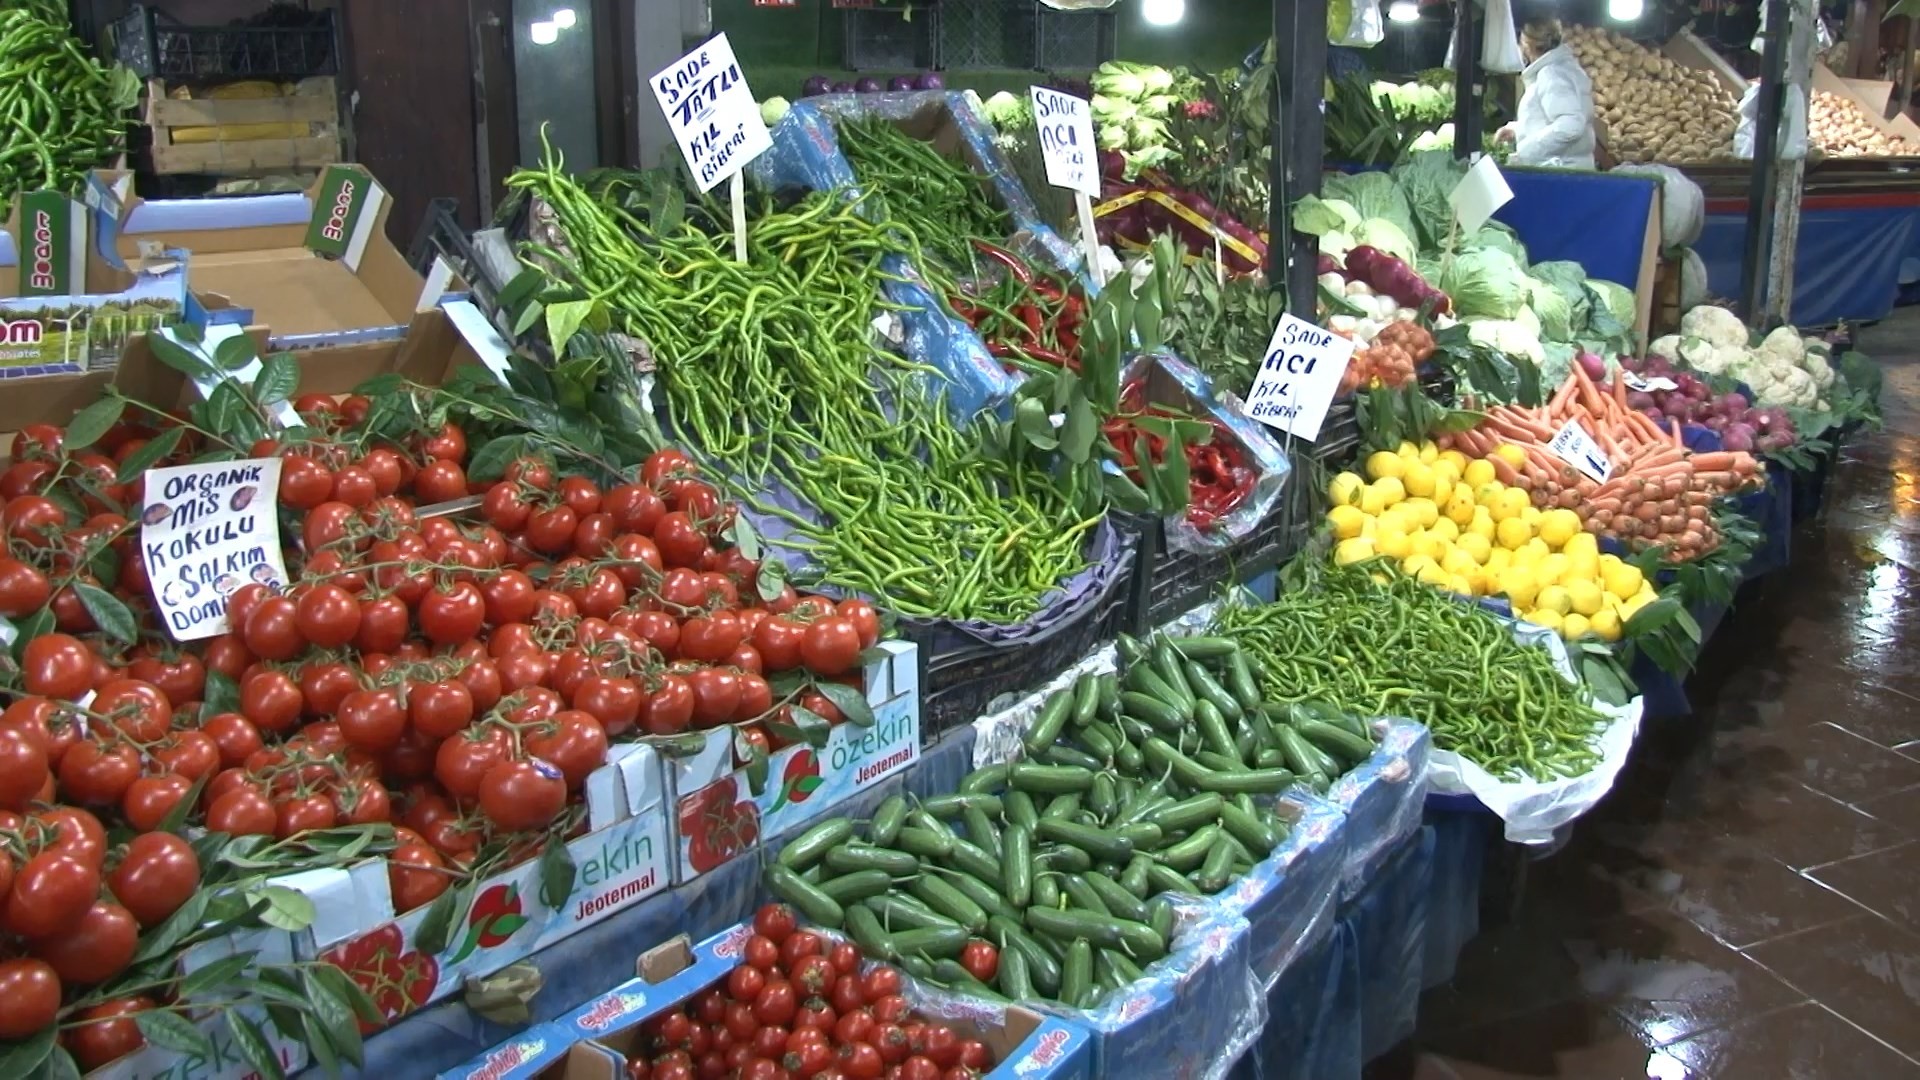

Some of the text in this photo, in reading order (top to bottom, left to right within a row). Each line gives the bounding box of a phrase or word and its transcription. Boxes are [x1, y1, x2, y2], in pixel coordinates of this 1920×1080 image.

[660, 51, 711, 104] SADE
[672, 64, 739, 126] TATLI
[1036, 91, 1078, 118] SADE
[690, 122, 721, 163] KIL
[1042, 123, 1077, 151] ACI
[1282, 323, 1332, 348] SADE
[1265, 348, 1317, 374] ACI
[1253, 381, 1290, 398] KIL
[147, 515, 255, 577] KOKULU
[831, 713, 911, 771] özekin
[855, 741, 913, 785] Jeotermal
[575, 866, 655, 921] Jeotermal
